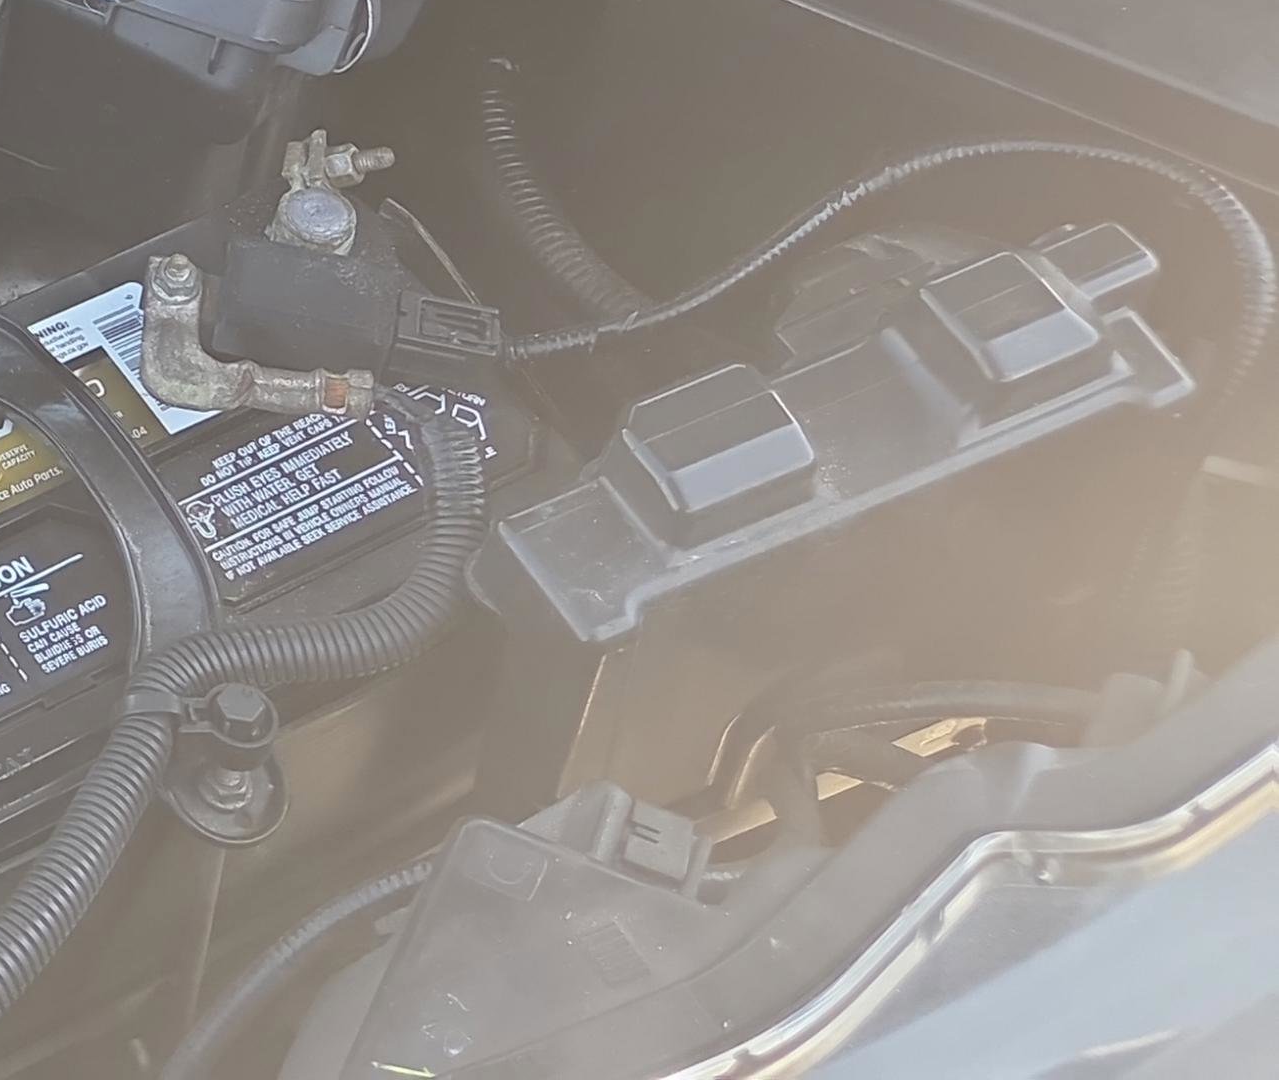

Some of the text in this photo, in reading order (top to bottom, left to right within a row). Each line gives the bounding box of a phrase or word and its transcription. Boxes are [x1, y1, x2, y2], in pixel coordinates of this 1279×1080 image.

[2, 450, 36, 470] CAPACITY
[201, 474, 216, 486] DO
[215, 465, 236, 480] NOT
[257, 443, 281, 461] KEEP
[281, 432, 307, 448] VENT
[307, 419, 333, 435] CAPS
[212, 451, 236, 469] KEEP
[237, 442, 257, 457] OUT
[258, 434, 272, 447] OF
[272, 426, 293, 441] THE
[250, 467, 281, 490] EYES
[281, 431, 353, 474] IMMEDIATELY
[10, 478, 34, 497] Auto
[221, 495, 252, 517] WITH
[296, 463, 321, 481] GET
[231, 469, 343, 530] MEDICAL HELP FAST
[253, 529, 273, 542] FOR
[272, 518, 296, 533] SAFE
[296, 504, 321, 521] JUMP
[320, 481, 364, 510] STARTING
[364, 465, 400, 488] FOLLOW
[220, 535, 283, 570] INSTRUCTIONS
[283, 528, 295, 540] IN
[294, 511, 330, 536] VEHICLE
[367, 478, 407, 500] MANUAL
[225, 570, 235, 582] IF
[236, 562, 256, 576] NOT
[258, 537, 303, 566] AVAILABLE
[303, 529, 326, 545] SEEK
[326, 510, 362, 533] SERVICE
[19, 595, 107, 643] SULFURIC ACID
[27, 622, 81, 653] CAN CAUSE
[34, 626, 101, 664] BLINDNESS OR
[42, 635, 109, 673] SEVERE BURNS
